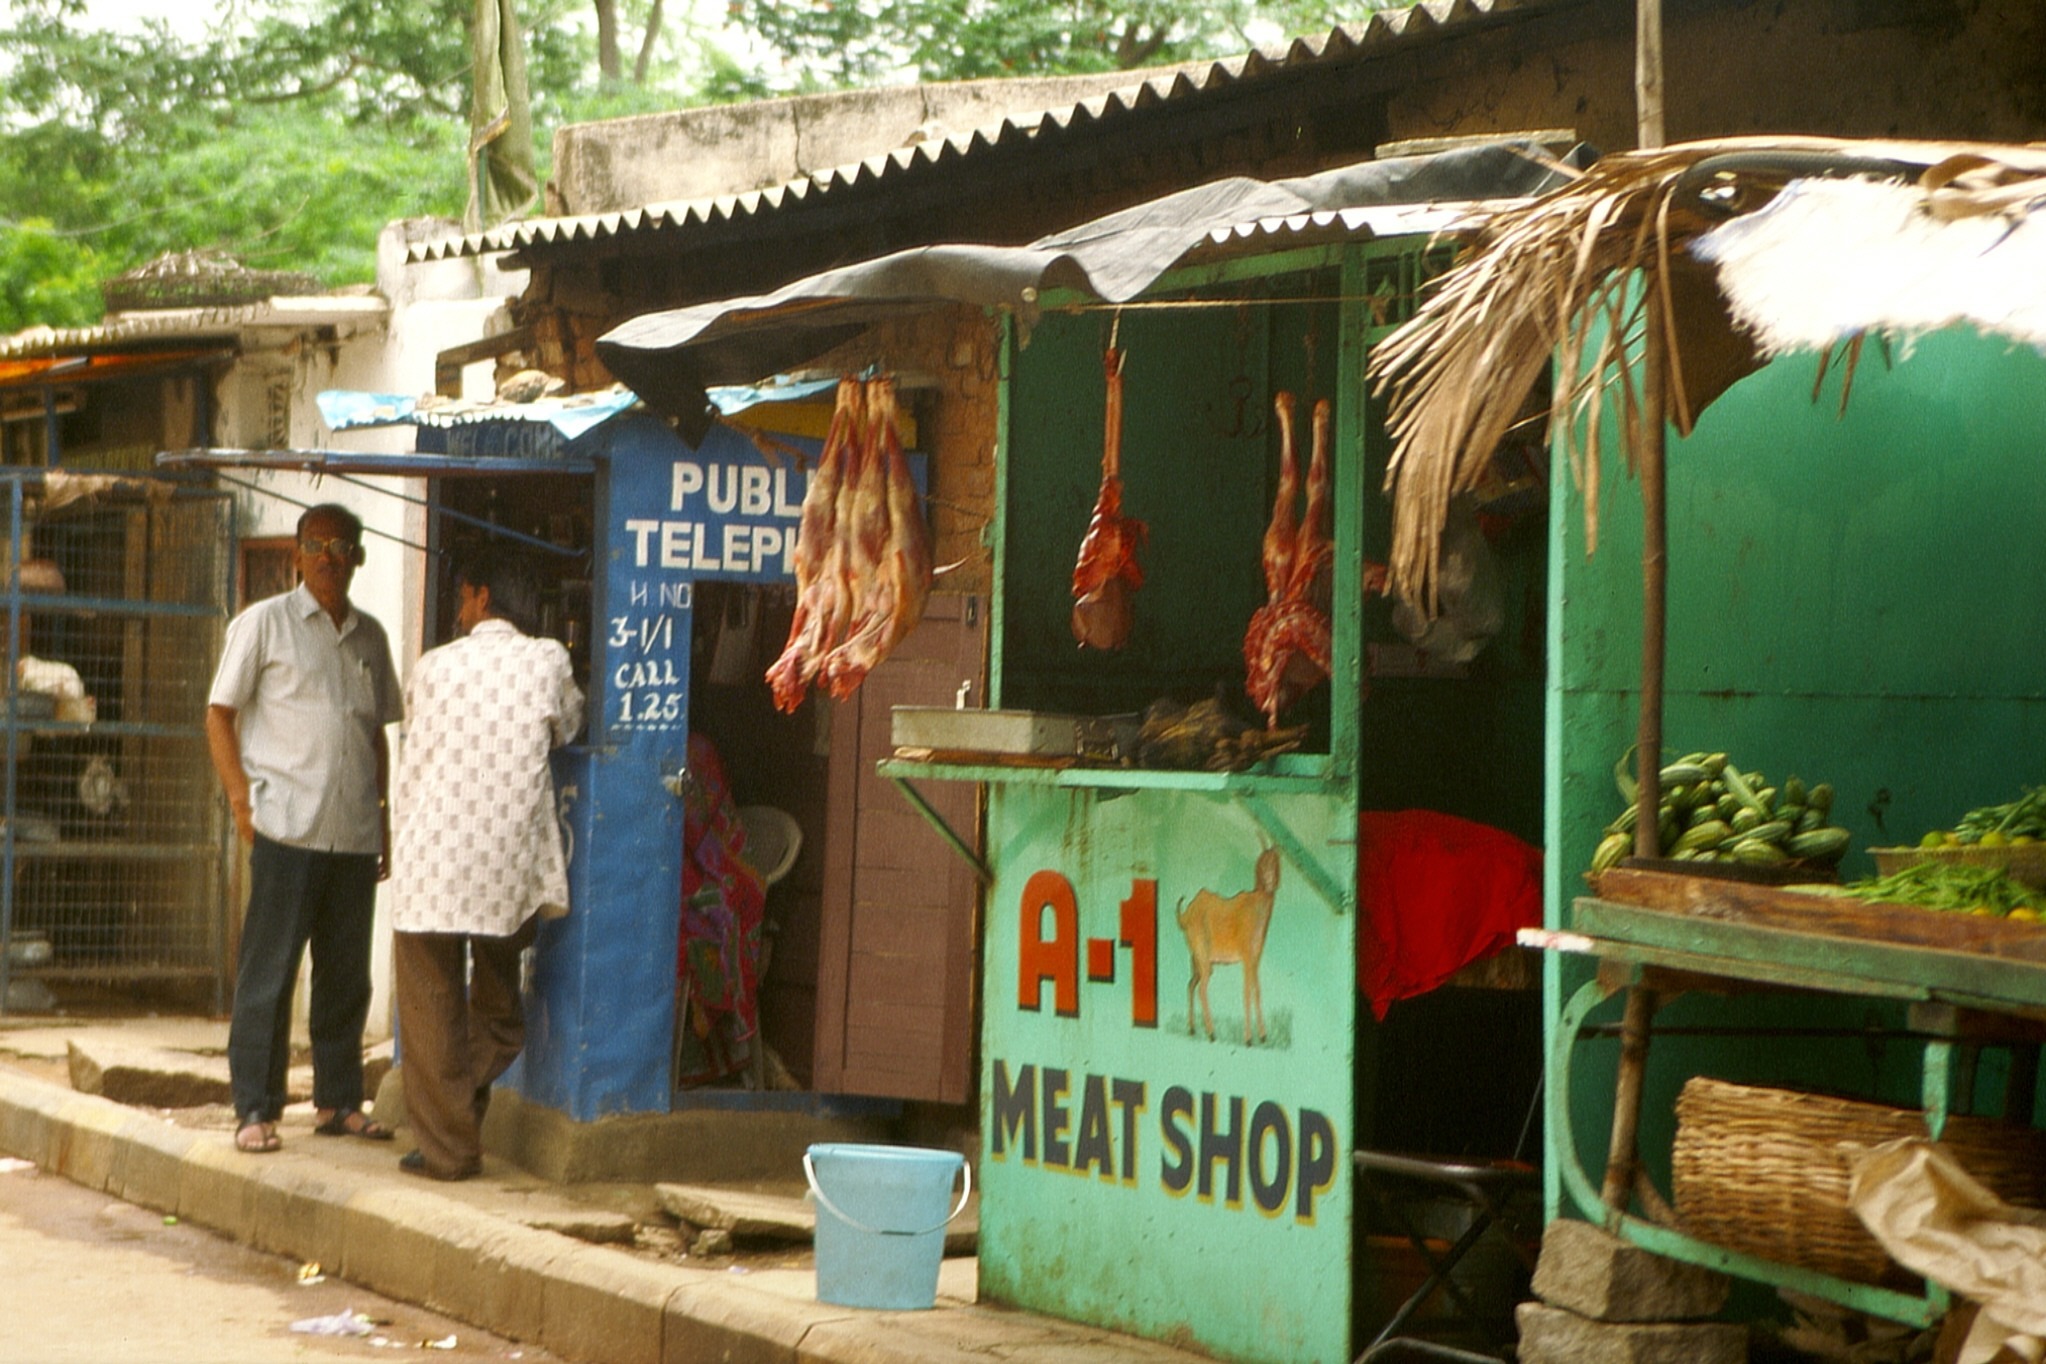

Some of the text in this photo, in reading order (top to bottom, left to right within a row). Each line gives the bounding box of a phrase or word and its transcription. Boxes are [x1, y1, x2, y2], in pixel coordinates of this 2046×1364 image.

[608, 613, 673, 655] 3-1/1
[614, 659, 680, 689] CALL
[619, 690, 683, 722] 1.25
[1017, 869, 1159, 1029] A-1
[991, 1058, 1339, 1228] MEAT SHOP
